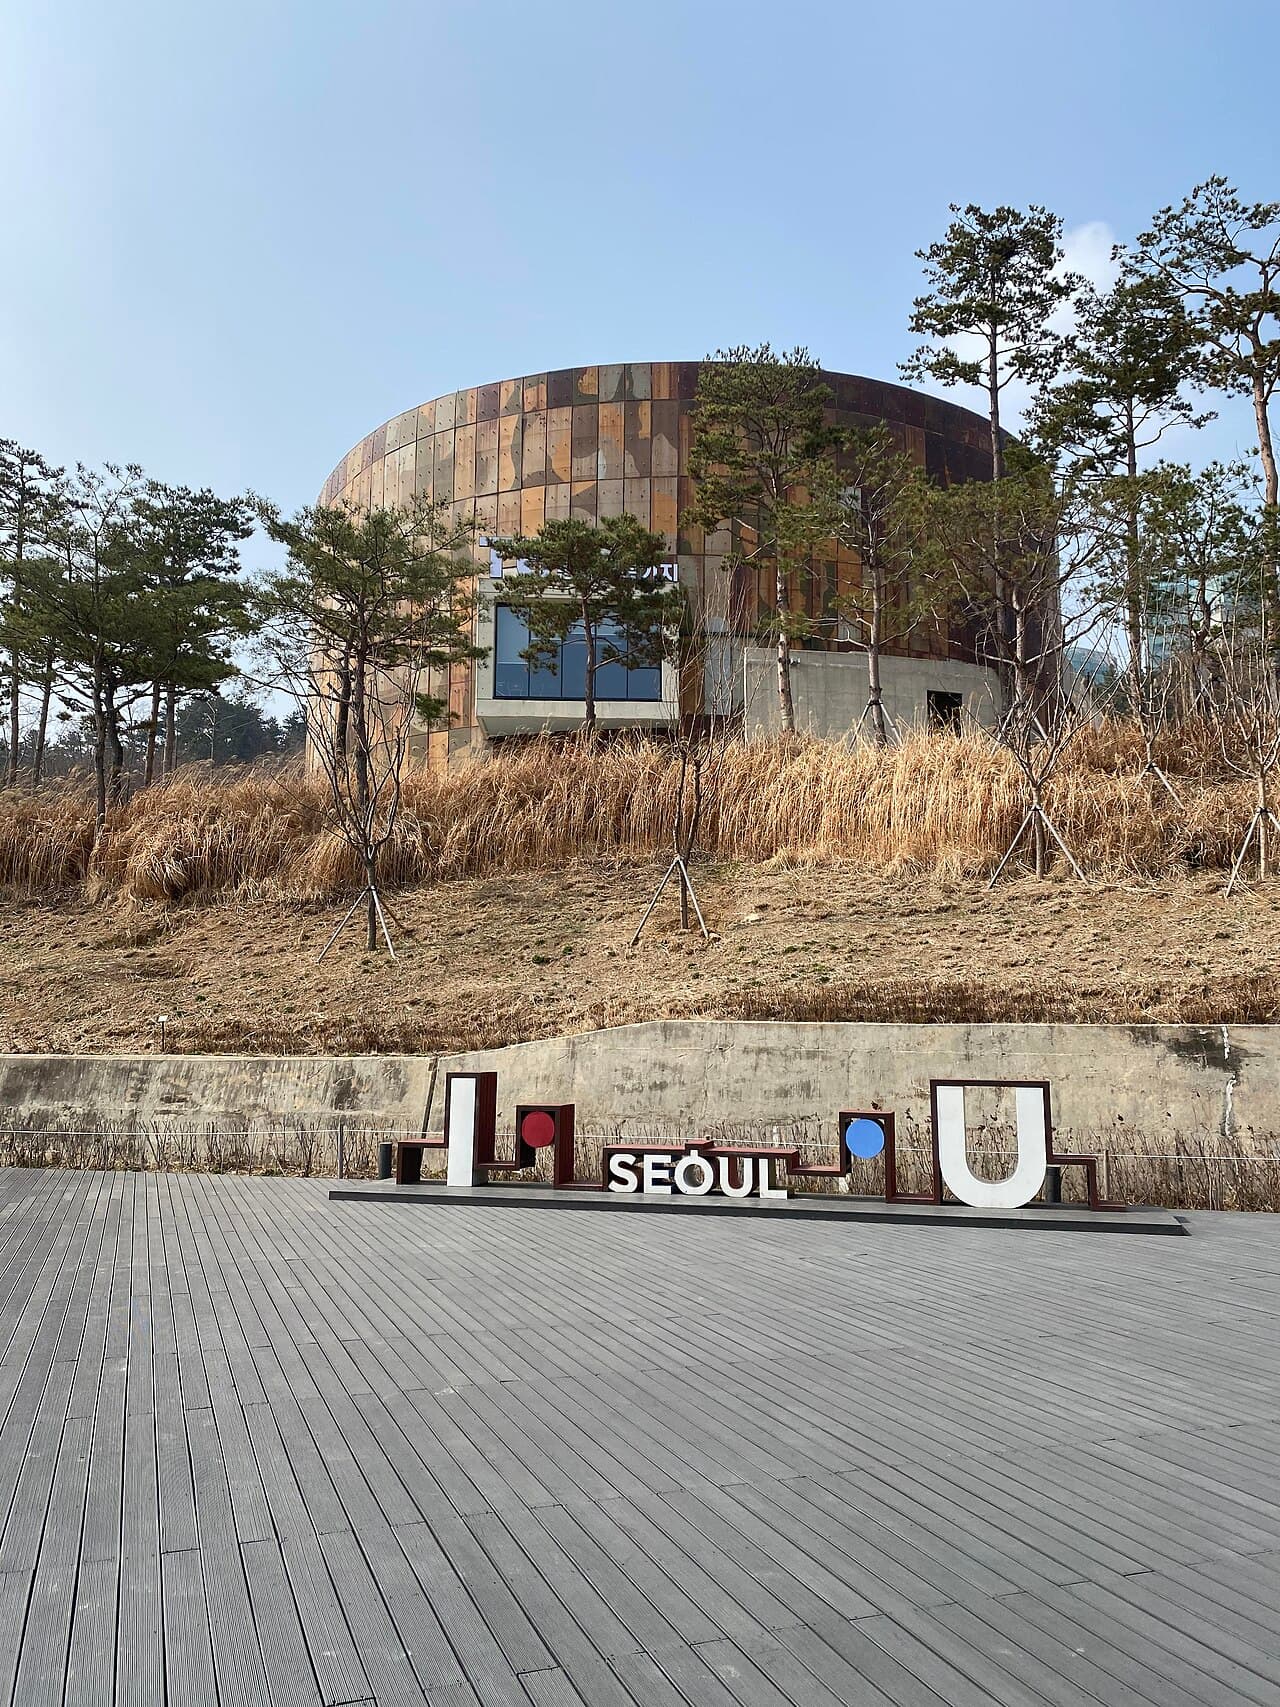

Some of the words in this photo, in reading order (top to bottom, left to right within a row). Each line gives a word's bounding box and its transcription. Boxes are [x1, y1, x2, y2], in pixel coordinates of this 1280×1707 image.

[447, 1077, 477, 1187] I
[607, 1149, 788, 1200] SEOUL
[936, 1086, 1047, 1209] U
